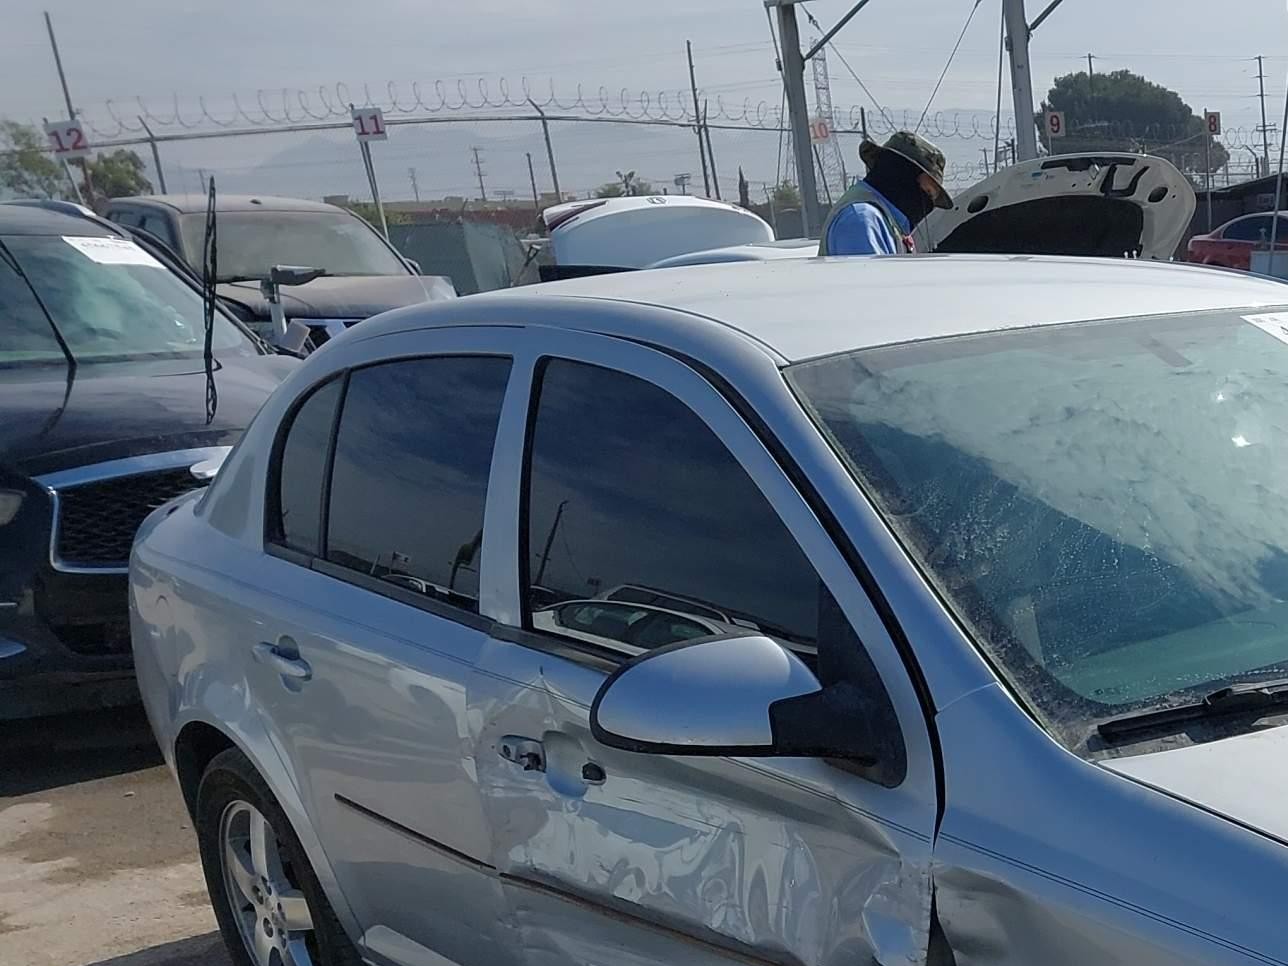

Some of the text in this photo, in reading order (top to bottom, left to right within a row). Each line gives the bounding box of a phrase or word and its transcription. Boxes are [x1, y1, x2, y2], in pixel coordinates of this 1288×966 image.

[354, 115, 385, 136] 11
[810, 122, 828, 139] 10
[1049, 115, 1060, 134] 9
[1208, 115, 1217, 132] 8
[48, 128, 88, 153] 12
